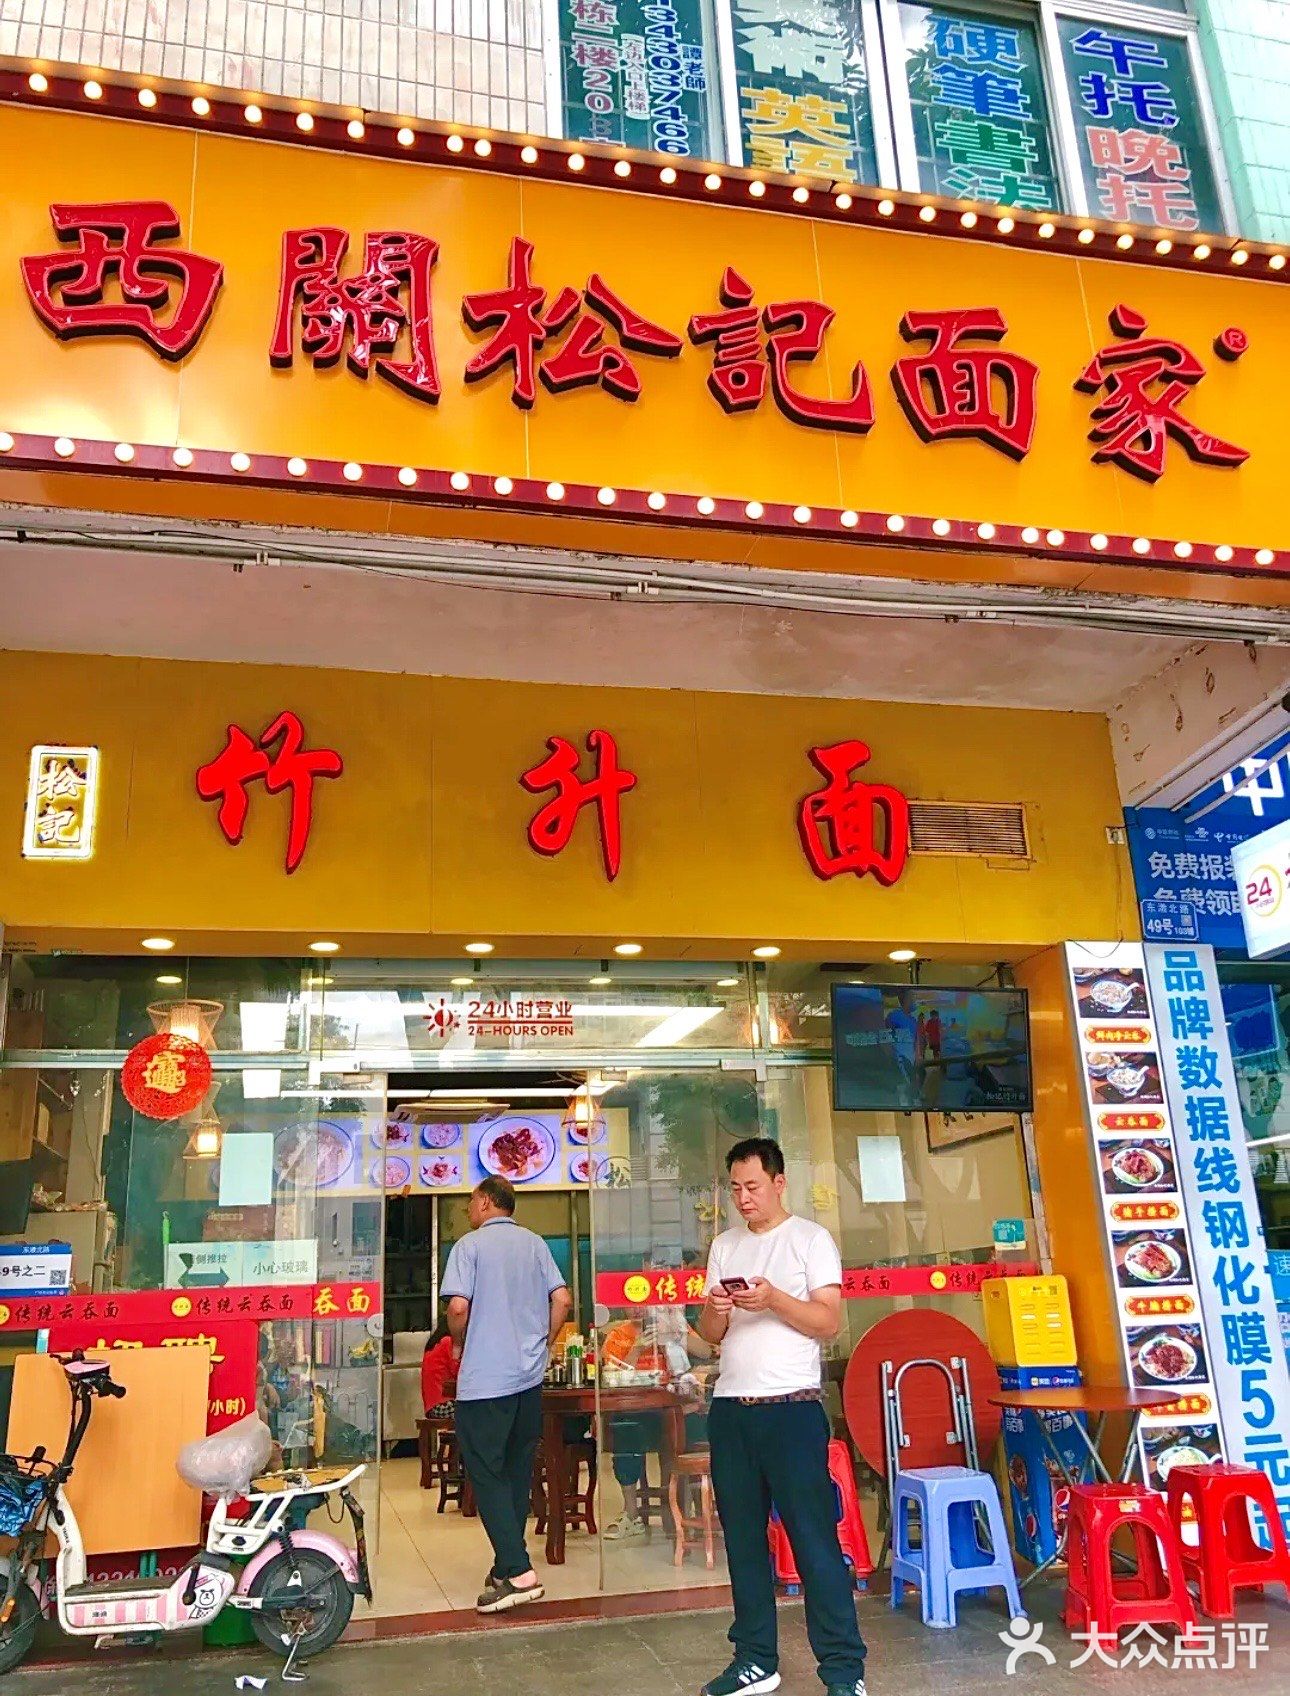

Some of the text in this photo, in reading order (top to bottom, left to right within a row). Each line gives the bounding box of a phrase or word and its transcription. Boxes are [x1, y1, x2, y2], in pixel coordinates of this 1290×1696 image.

[641, 0, 691, 156] 343037466
[926, 14, 1051, 210] 硬筆書法
[196, 711, 911, 885] 竹升面
[1222, 755, 1290, 817] 中
[1245, 876, 1273, 906] 24
[1147, 919, 1174, 935] 49号
[468, 1000, 573, 1019] 24小时营业
[468, 1026, 573, 1036] 24-HOURS OPEN
[0, 1264, 46, 1277] 9号之二
[15, 1301, 119, 1323] 传统云吞面
[196, 1294, 294, 1315] 传统云吞面
[313, 1287, 371, 1316] 吞面
